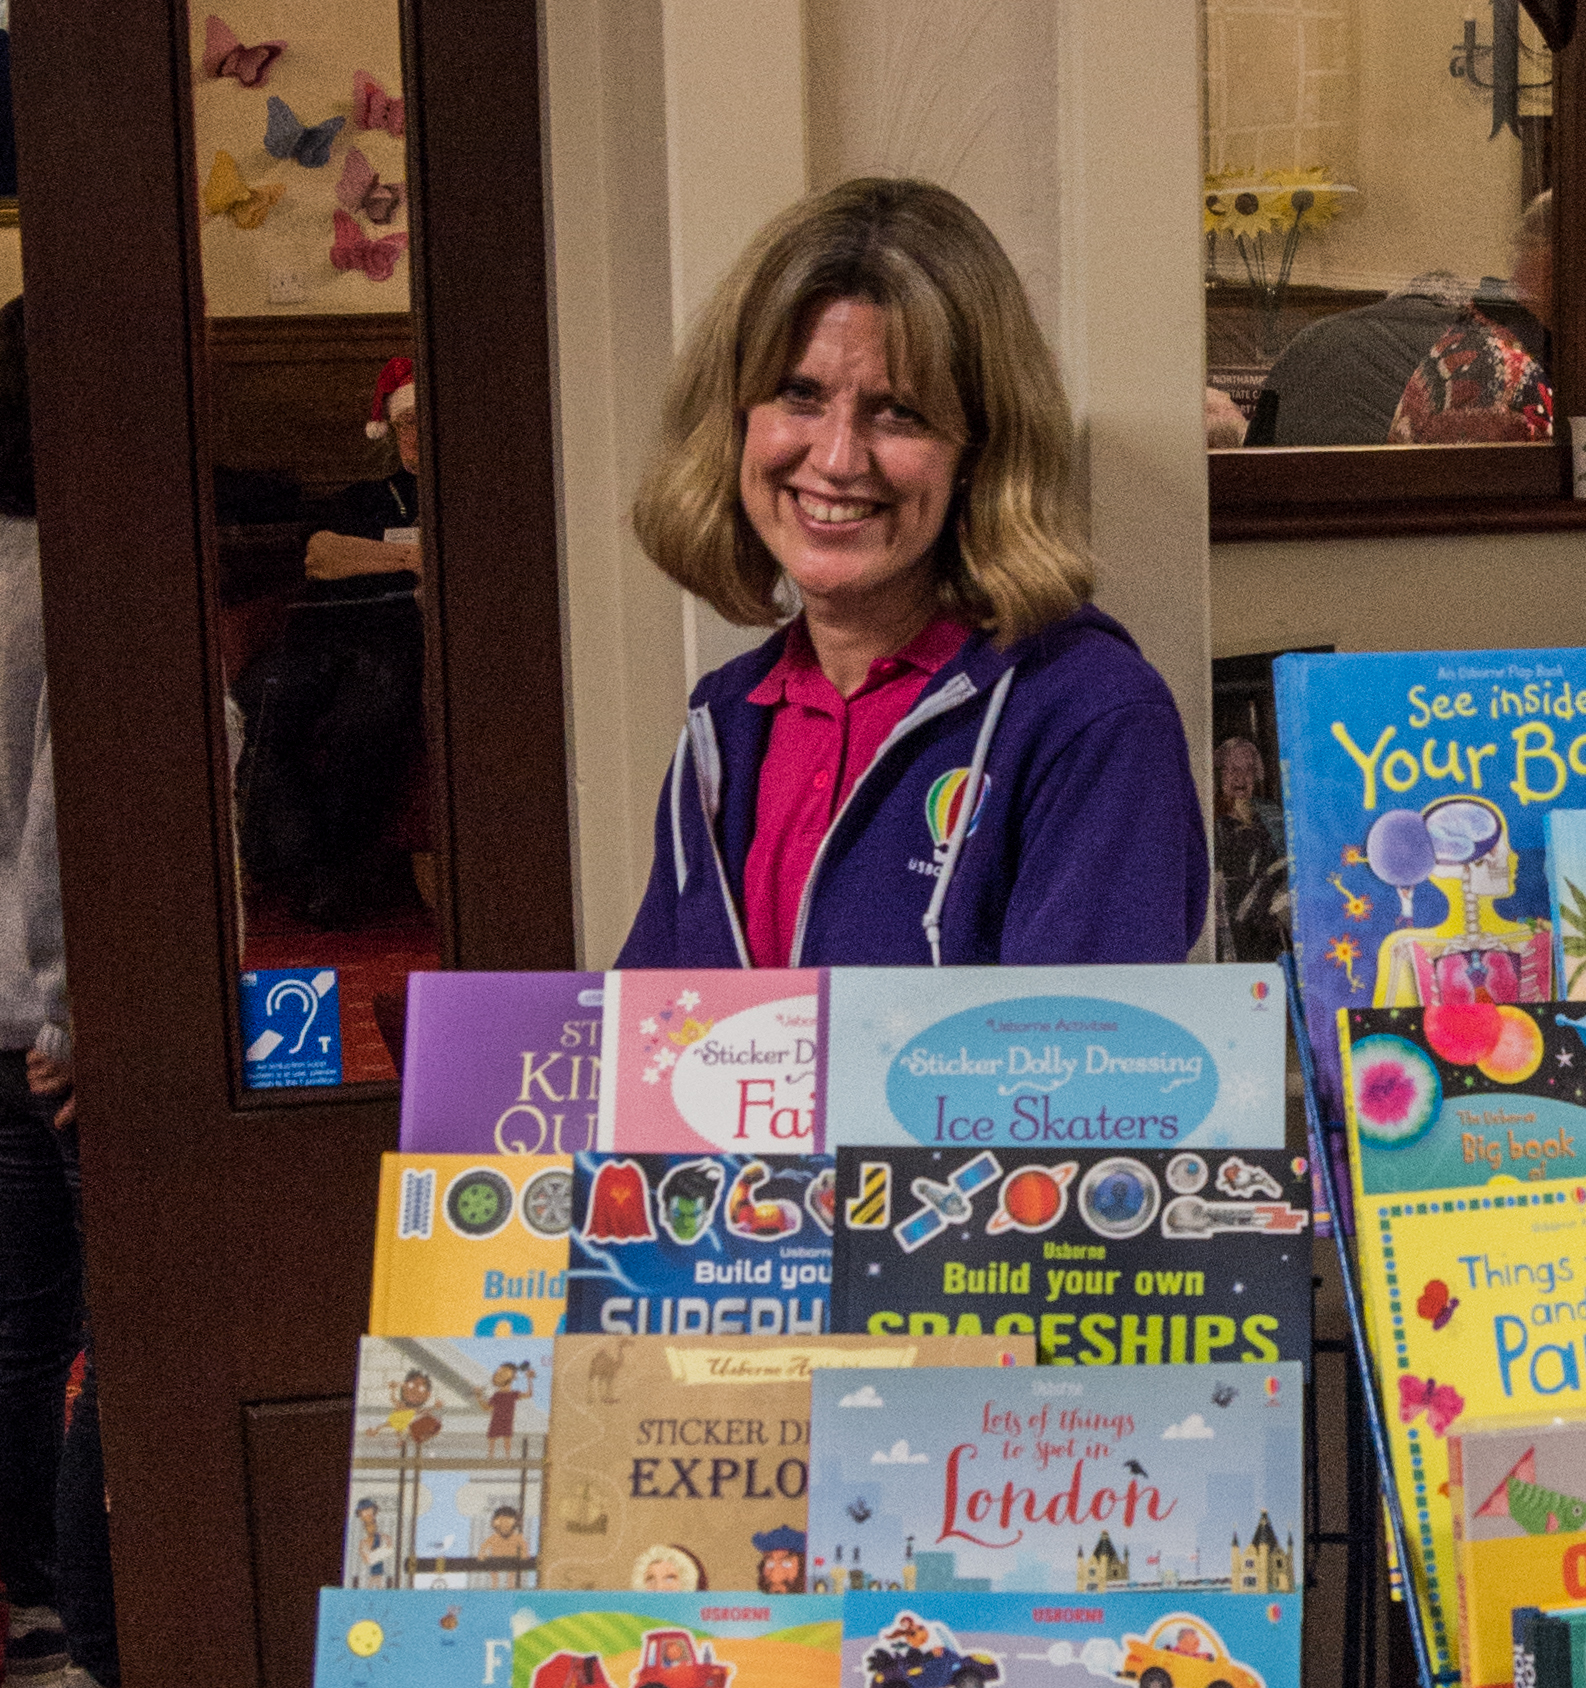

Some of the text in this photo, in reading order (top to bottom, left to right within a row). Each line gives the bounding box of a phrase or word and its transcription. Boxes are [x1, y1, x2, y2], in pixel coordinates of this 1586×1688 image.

[1408, 685, 1477, 729] See
[1332, 721, 1497, 810] Your
[318, 1035, 332, 1054] T
[902, 1046, 1204, 1088] Sticker Dolly Dressing
[934, 1095, 1180, 1142] Ice Skaters
[1462, 1127, 1577, 1169] Big book
[943, 1262, 1205, 1302] Build your own
[1458, 1250, 1574, 1293] Things
[628, 1457, 809, 1500] EXPLO
[935, 1442, 1179, 1550] London
[699, 1607, 773, 1624] USBORNE
[1032, 1608, 1106, 1624] USBORNE
